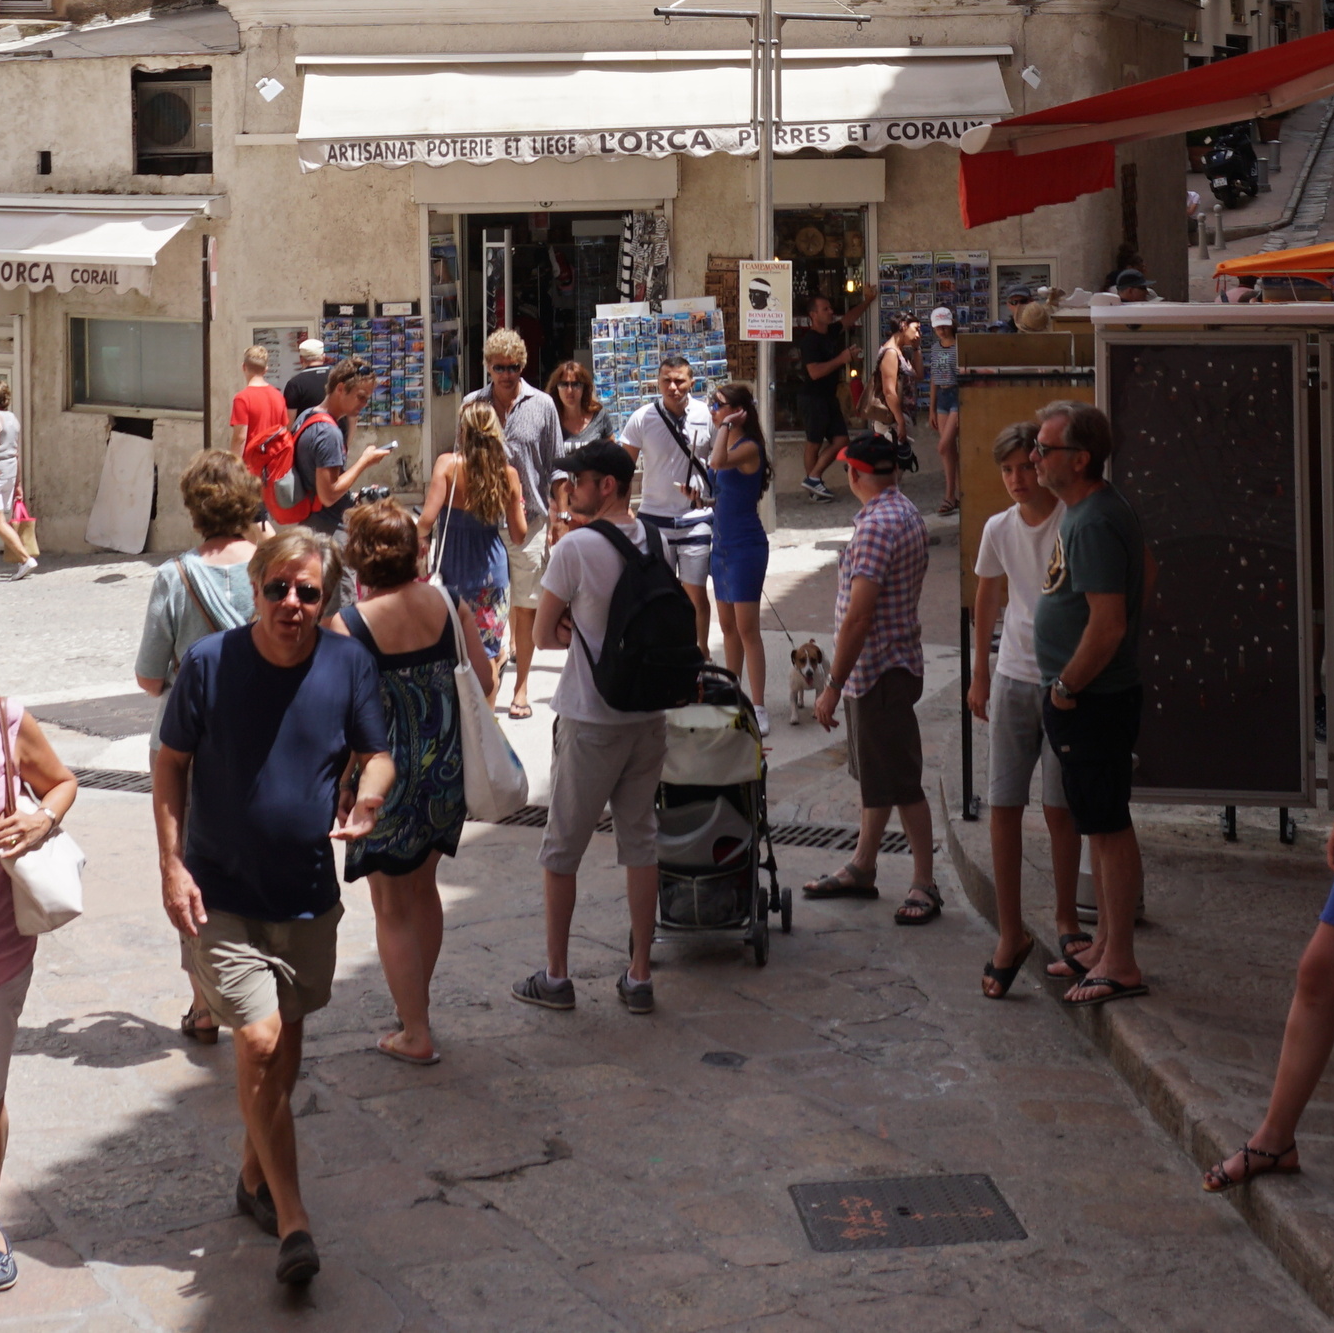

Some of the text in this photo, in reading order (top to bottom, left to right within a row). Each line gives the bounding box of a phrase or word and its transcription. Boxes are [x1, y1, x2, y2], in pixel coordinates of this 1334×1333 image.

[327, 140, 416, 164] ARTISANAT
[426, 136, 494, 159] POTERIE
[504, 136, 522, 157] ET
[532, 135, 577, 156] LIEGE
[599, 129, 712, 154] L'ORCA
[738, 123, 832, 147] PIRRES
[847, 122, 869, 143] ET
[70, 267, 120, 286] CORAIL
